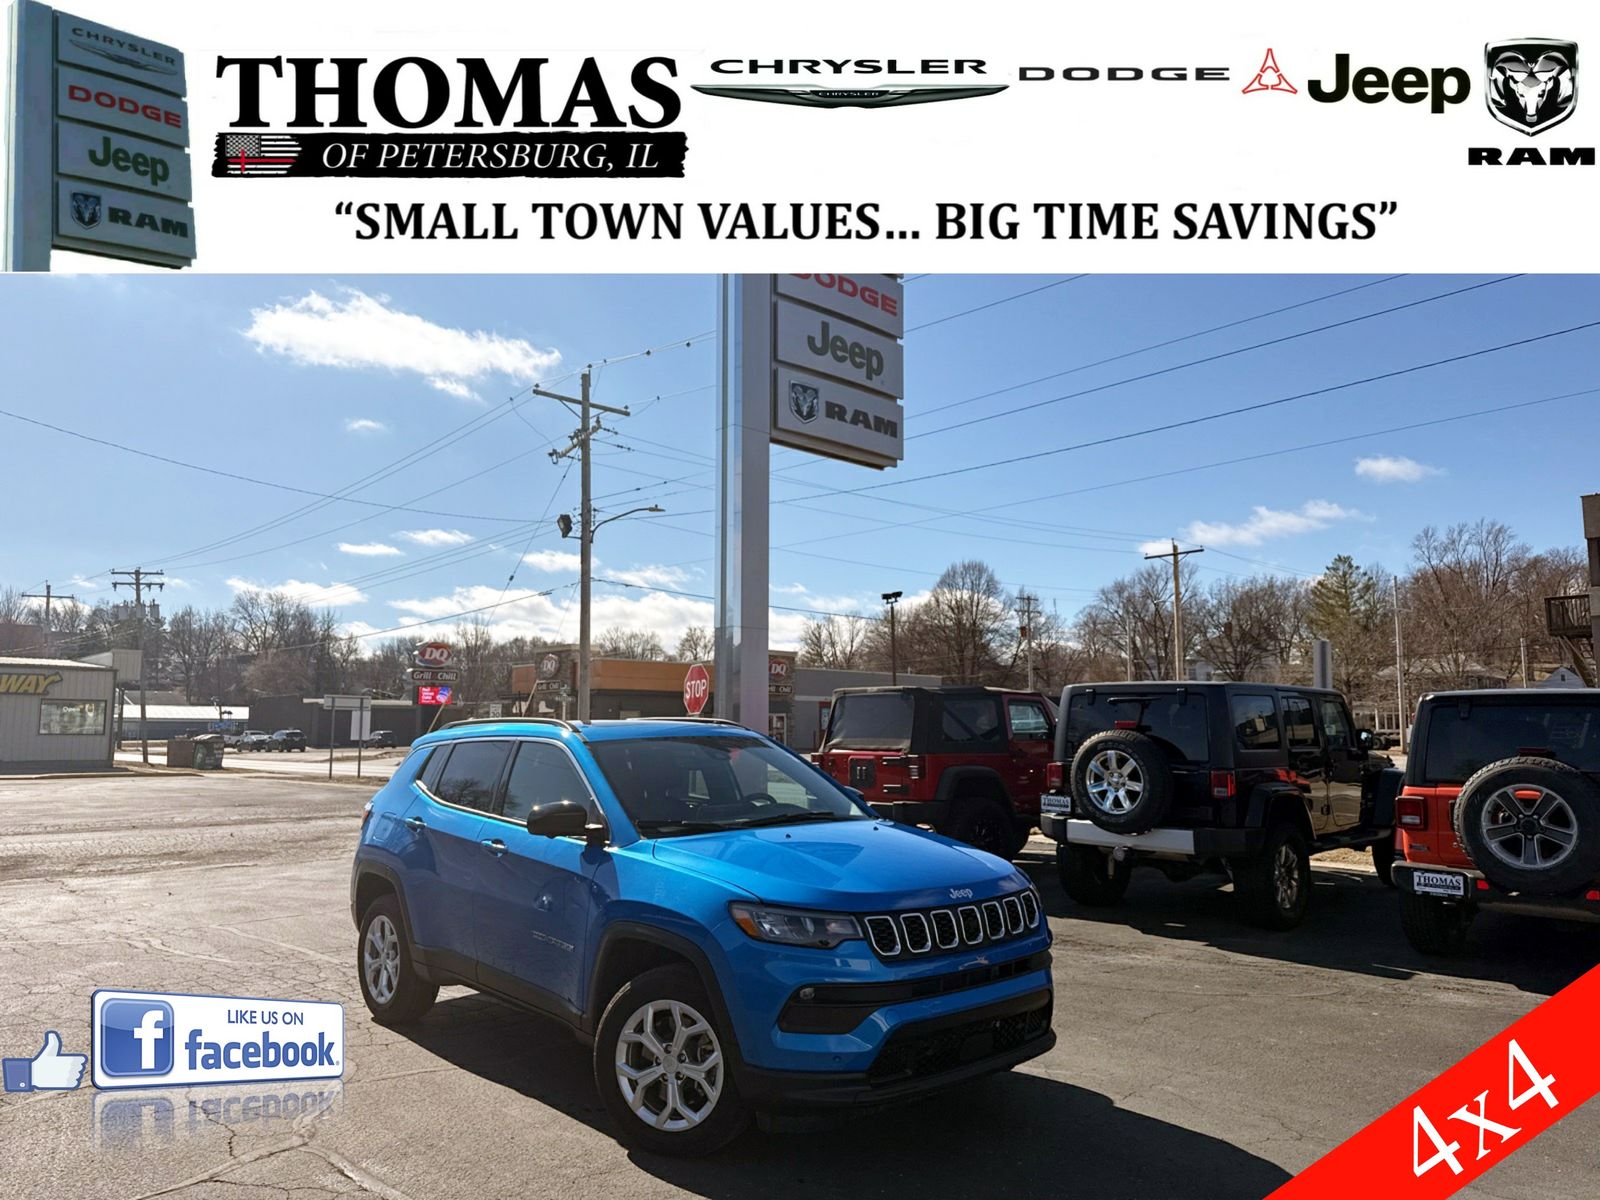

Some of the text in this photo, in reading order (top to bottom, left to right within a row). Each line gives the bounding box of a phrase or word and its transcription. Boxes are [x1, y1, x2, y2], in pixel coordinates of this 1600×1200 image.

[807, 320, 884, 381] Jeep
[825, 401, 898, 439] RAM
[424, 647, 449, 662] DQ
[543, 660, 556, 672] DQ
[770, 663, 786, 676] DQ
[413, 671, 457, 681] Grill Chill
[685, 679, 707, 699] STOP
[1416, 875, 1461, 886] THOMAS
[949, 888, 973, 899] Jeep
